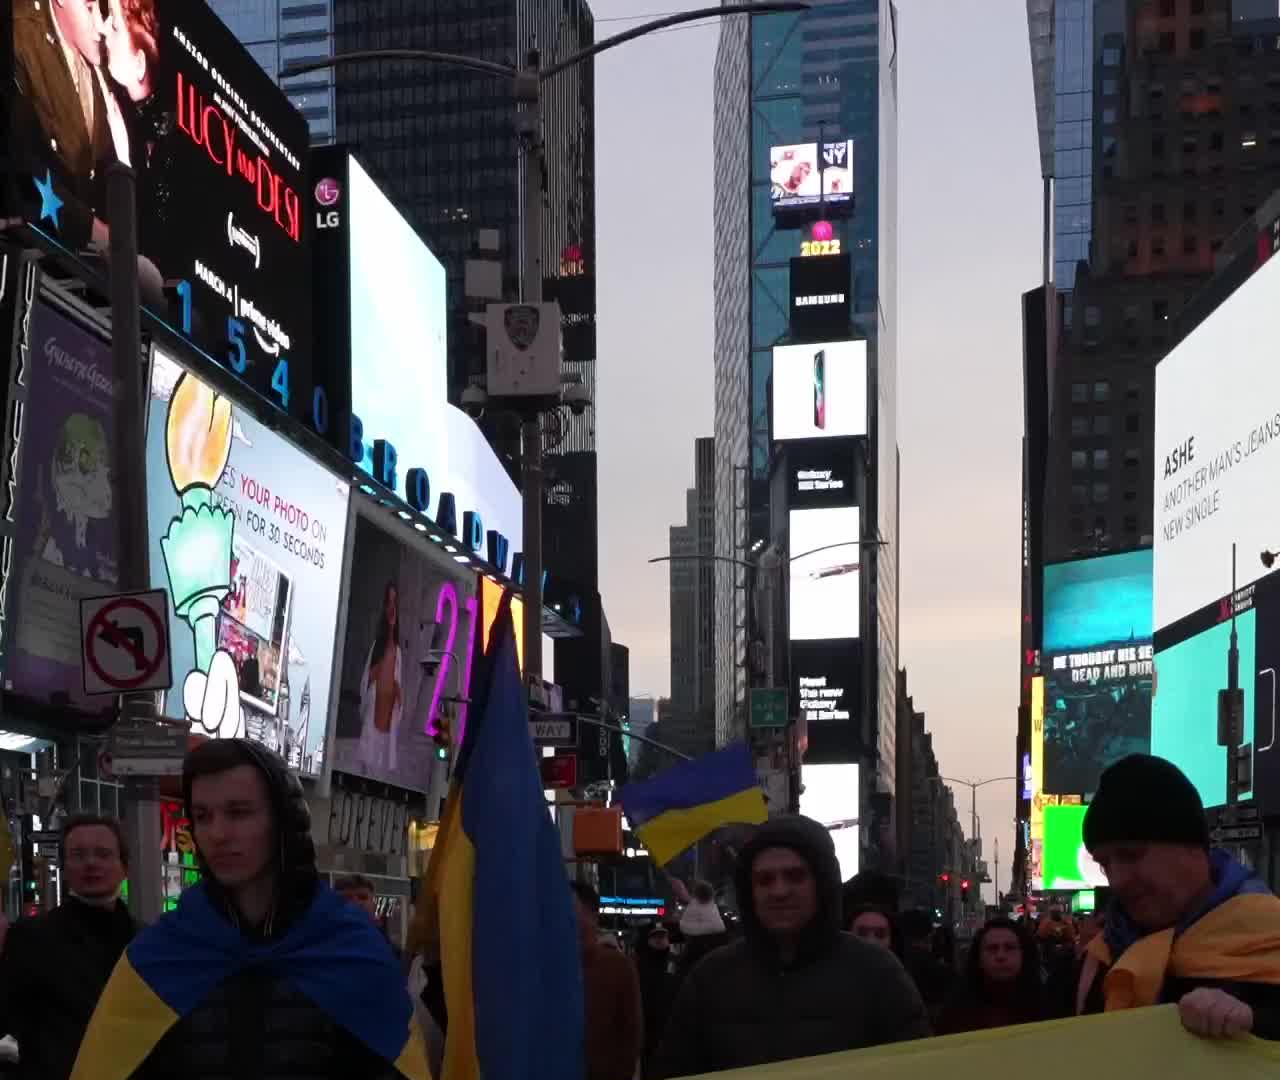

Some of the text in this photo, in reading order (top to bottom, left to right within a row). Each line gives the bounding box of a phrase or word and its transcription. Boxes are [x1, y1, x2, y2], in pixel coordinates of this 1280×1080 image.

[177, 71, 236, 177] LUCY
[256, 155, 300, 243] DESI
[316, 211, 339, 229] LG
[1163, 435, 1195, 481] ASHE
[1163, 412, 1280, 513] ANOTHER MAN'S JEANS
[239, 473, 271, 511] YOUR
[273, 495, 310, 533] PHOTO
[311, 519, 327, 543] ON
[1163, 489, 1220, 542] NEW SINGLE
[246, 509, 267, 537] FOR
[282, 530, 326, 570] SECONDS
[1103, 663, 1126, 680] AND
